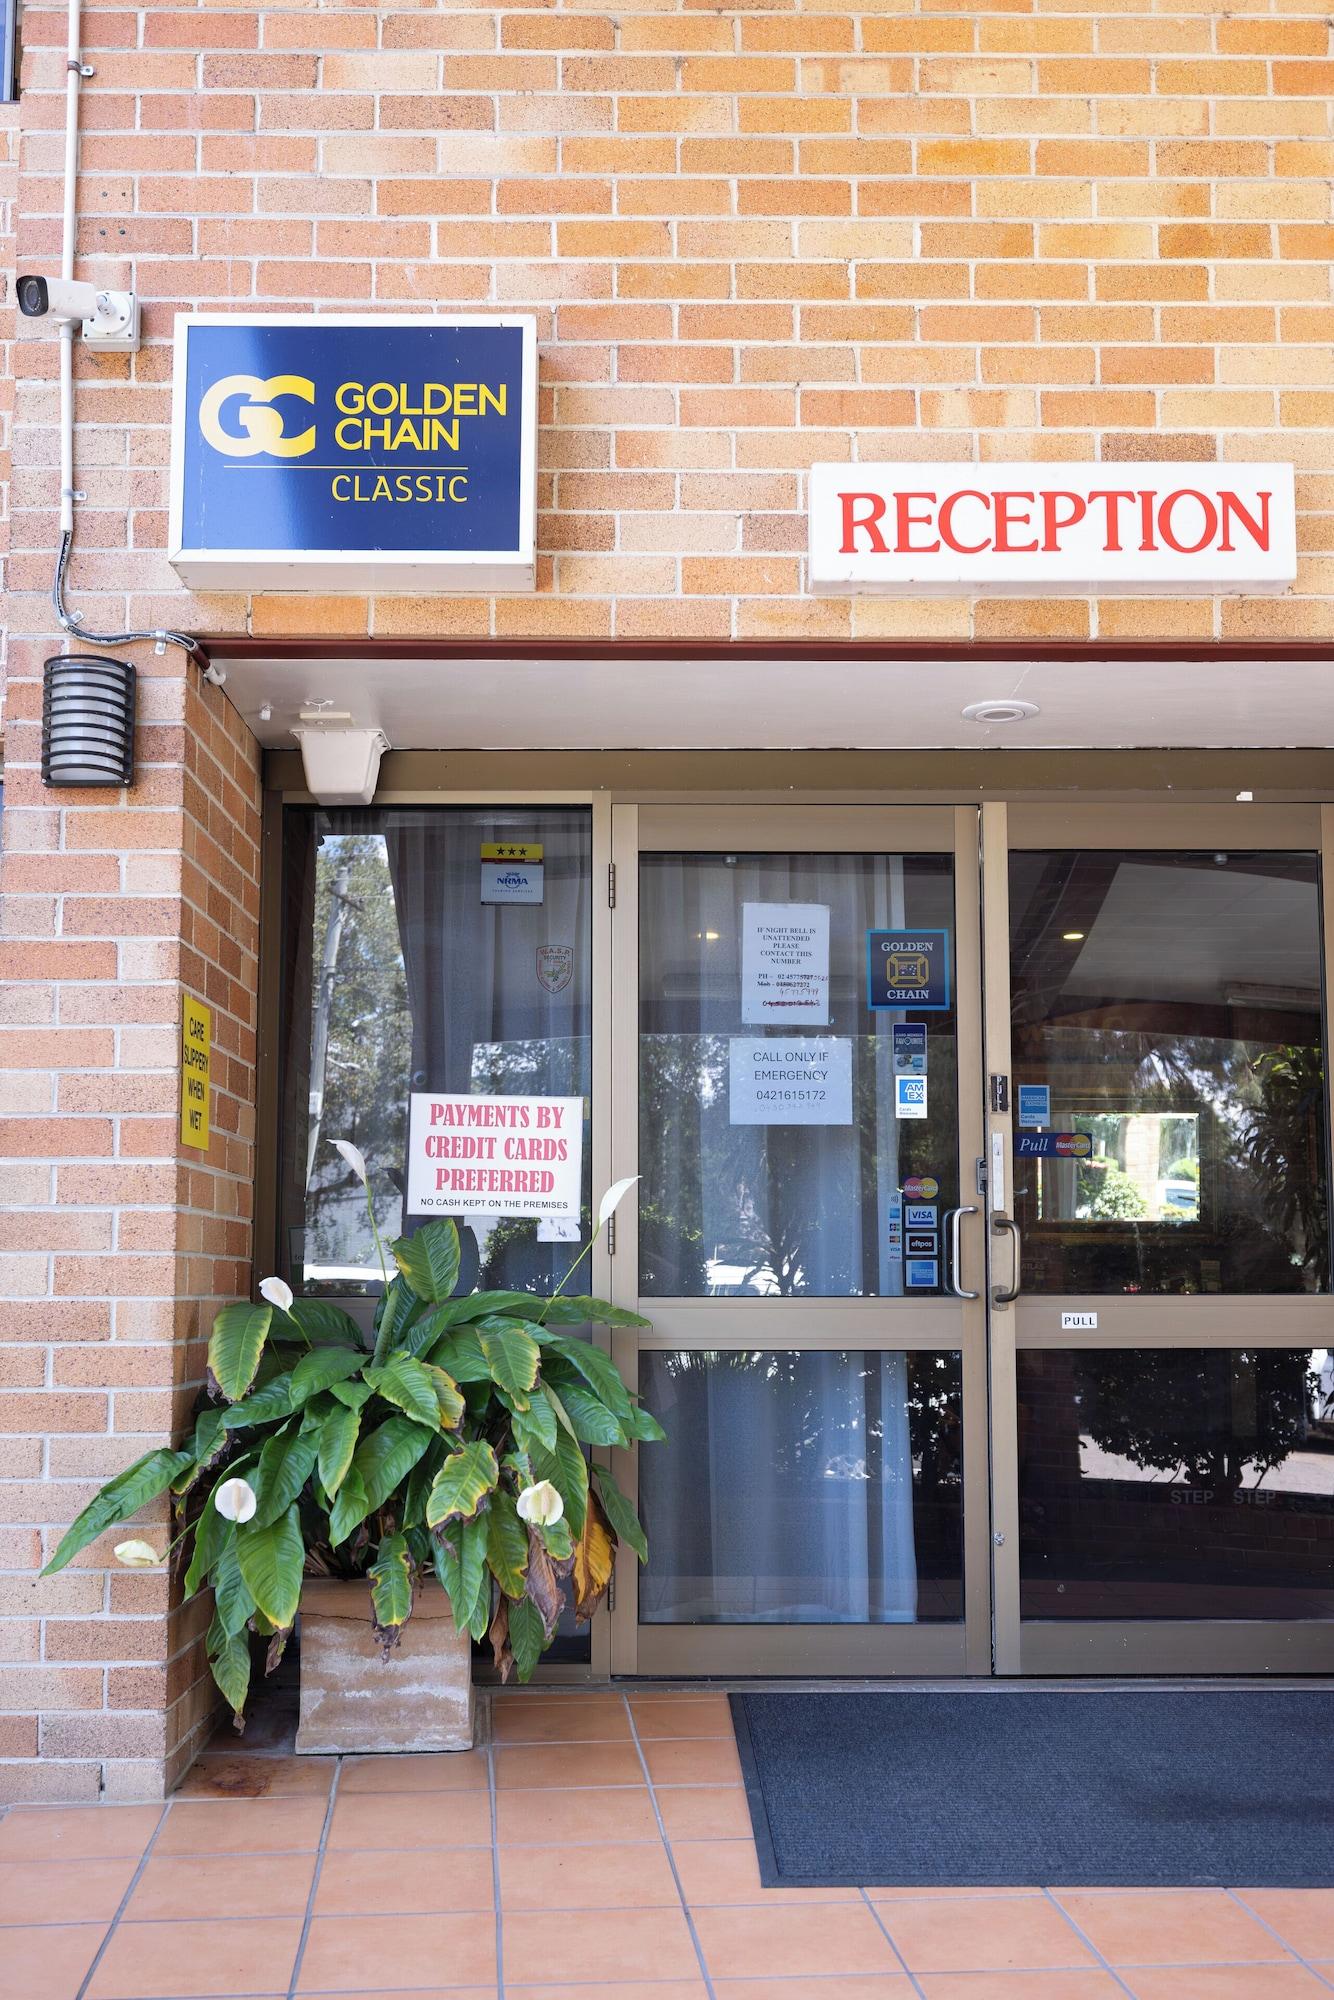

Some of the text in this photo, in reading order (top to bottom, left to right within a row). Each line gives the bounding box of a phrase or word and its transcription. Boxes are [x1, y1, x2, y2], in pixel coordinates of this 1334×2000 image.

[334, 381, 507, 416] GOLDEN
[334, 418, 460, 451] CHAIN
[332, 475, 468, 502] CLASSIC
[837, 489, 1272, 554] RECEPTION
[496, 877, 528, 885] NRMA
[881, 942, 934, 952] GOLDEN
[886, 990, 930, 999] CHAIN
[189, 1017, 204, 1042] CARE
[184, 1045, 209, 1074] SLIPPERY
[752, 1052, 829, 1062] CALL ONLY IF
[754, 1070, 828, 1080] EMERGENCY
[188, 1077, 205, 1102] WHEN
[756, 1090, 826, 1100] 0421615172
[189, 1108, 202, 1131] WET
[429, 1103, 565, 1129] PAYMENTS BY
[425, 1135, 568, 1162] CREDIT CARDS
[1019, 1138, 1049, 1152] Pull
[1055, 1141, 1091, 1149] MasterCard
[435, 1168, 555, 1193] PREFERRED
[420, 1198, 569, 1209] NO CASH KEPT ON THE PREMISES
[912, 1211, 933, 1219] VISA
[911, 1239, 933, 1249] eftpos
[1064, 1316, 1096, 1326] PULL
[1170, 1489, 1276, 1504] STEP STEP
